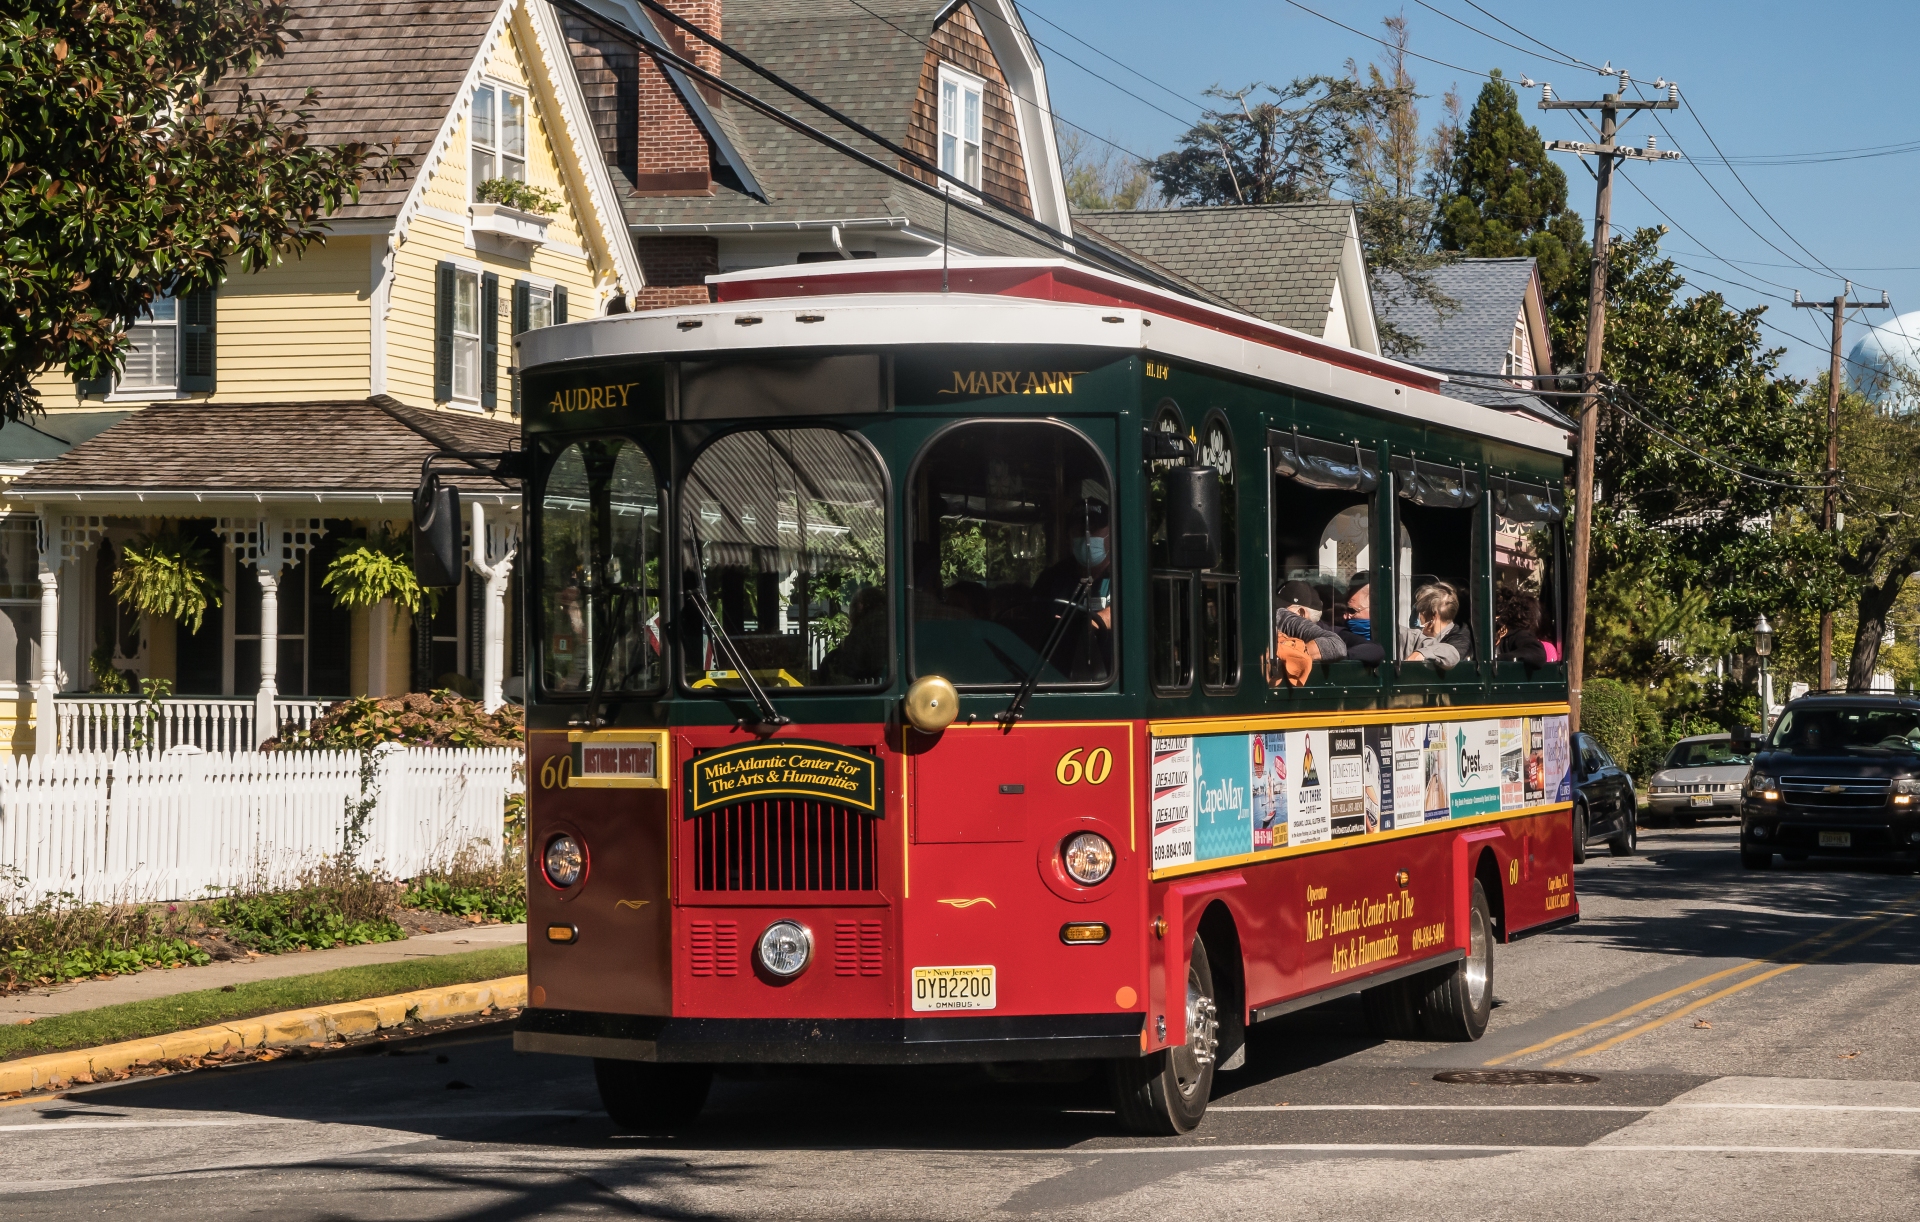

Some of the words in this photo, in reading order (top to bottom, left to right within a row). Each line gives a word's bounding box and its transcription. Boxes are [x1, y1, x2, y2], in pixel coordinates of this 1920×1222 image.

[937, 371, 1021, 394] MARY
[1021, 371, 1089, 394] ANN
[548, 383, 639, 413] AUDREY
[540, 755, 572, 789] 60
[704, 755, 786, 780] Mid-Atlantic
[788, 754, 834, 772] Center
[834, 760, 861, 776] For
[1055, 746, 1114, 786] 60
[1461, 747, 1480, 779] Crest
[709, 779, 735, 794] The
[736, 774, 764, 787] Arts
[766, 770, 780, 783] &
[782, 770, 859, 791] Humanities
[1155, 770, 1189, 787] DESATNICK
[1156, 805, 1190, 822] DESATNICK
[1509, 858, 1519, 886] 60
[1306, 884, 1327, 906] Operator
[1306, 908, 1323, 942] Mid
[1329, 899, 1361, 936] Atlantic
[1362, 897, 1386, 928] Center
[1387, 893, 1400, 923] For
[1401, 889, 1415, 919] The
[1331, 943, 1348, 974] Arts
[1349, 938, 1356, 969] &
[1358, 928, 1399, 966] Humanities
[933, 969, 950, 977] New
[951, 968, 975, 977] Jersey
